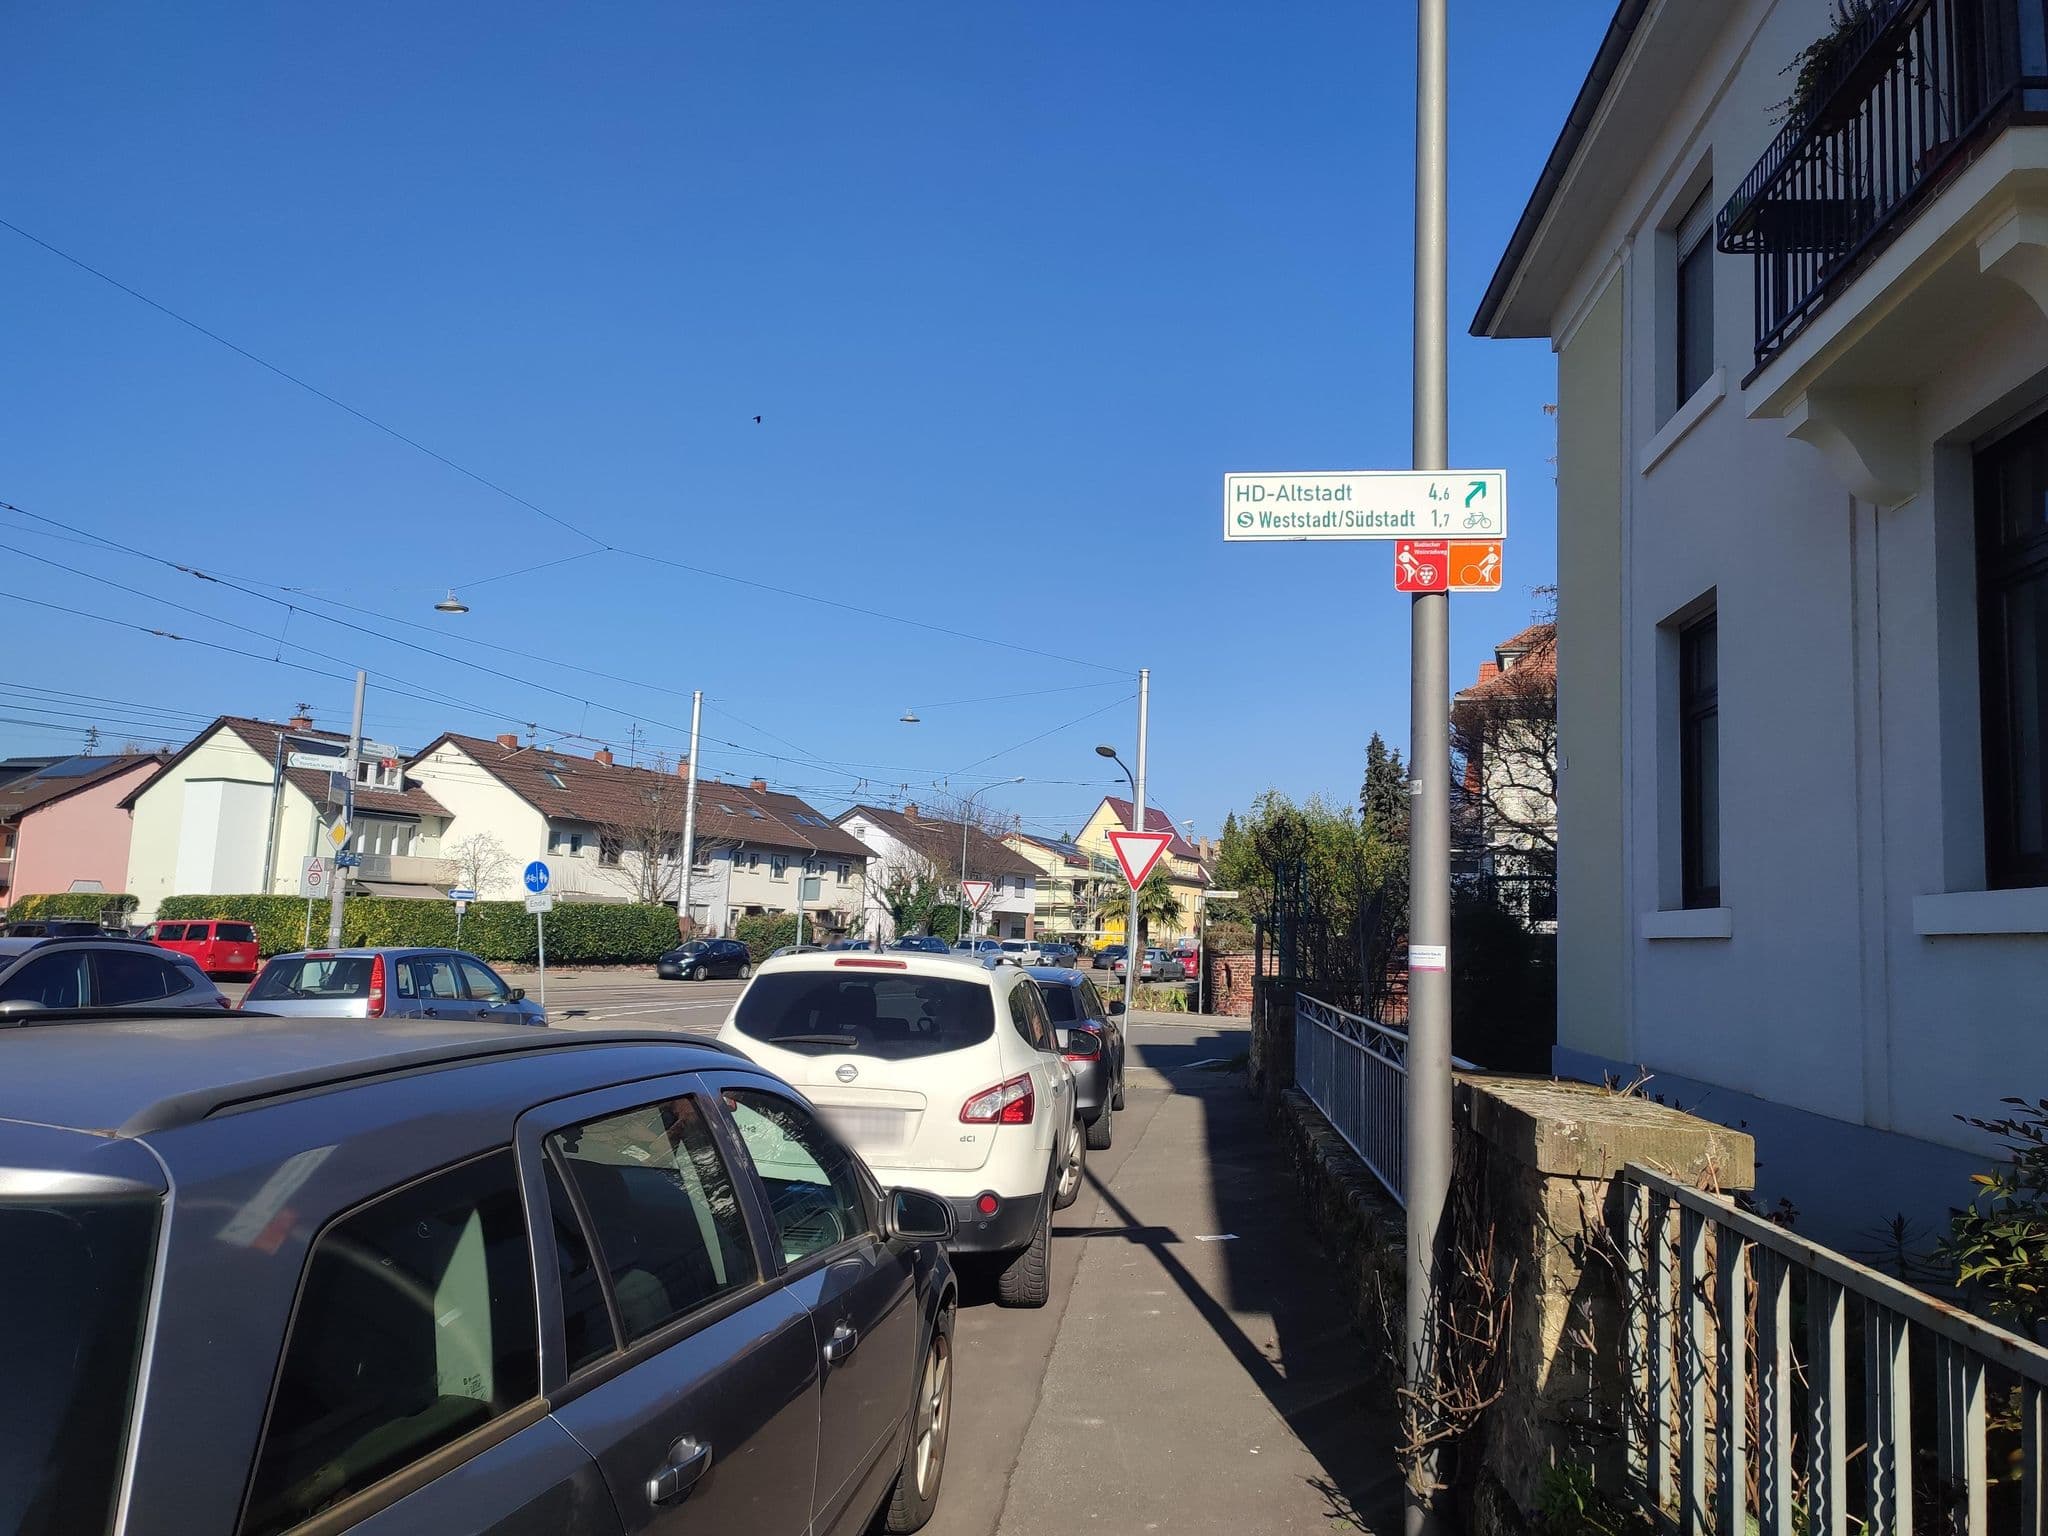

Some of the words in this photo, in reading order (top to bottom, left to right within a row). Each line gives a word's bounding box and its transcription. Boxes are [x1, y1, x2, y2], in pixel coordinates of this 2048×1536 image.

[1237, 484, 1352, 502] HD-Altstadt
[1428, 483, 1449, 502] 4,6
[1259, 509, 1415, 528] Weststadt/Südstadt
[1431, 509, 1449, 528] 1,7
